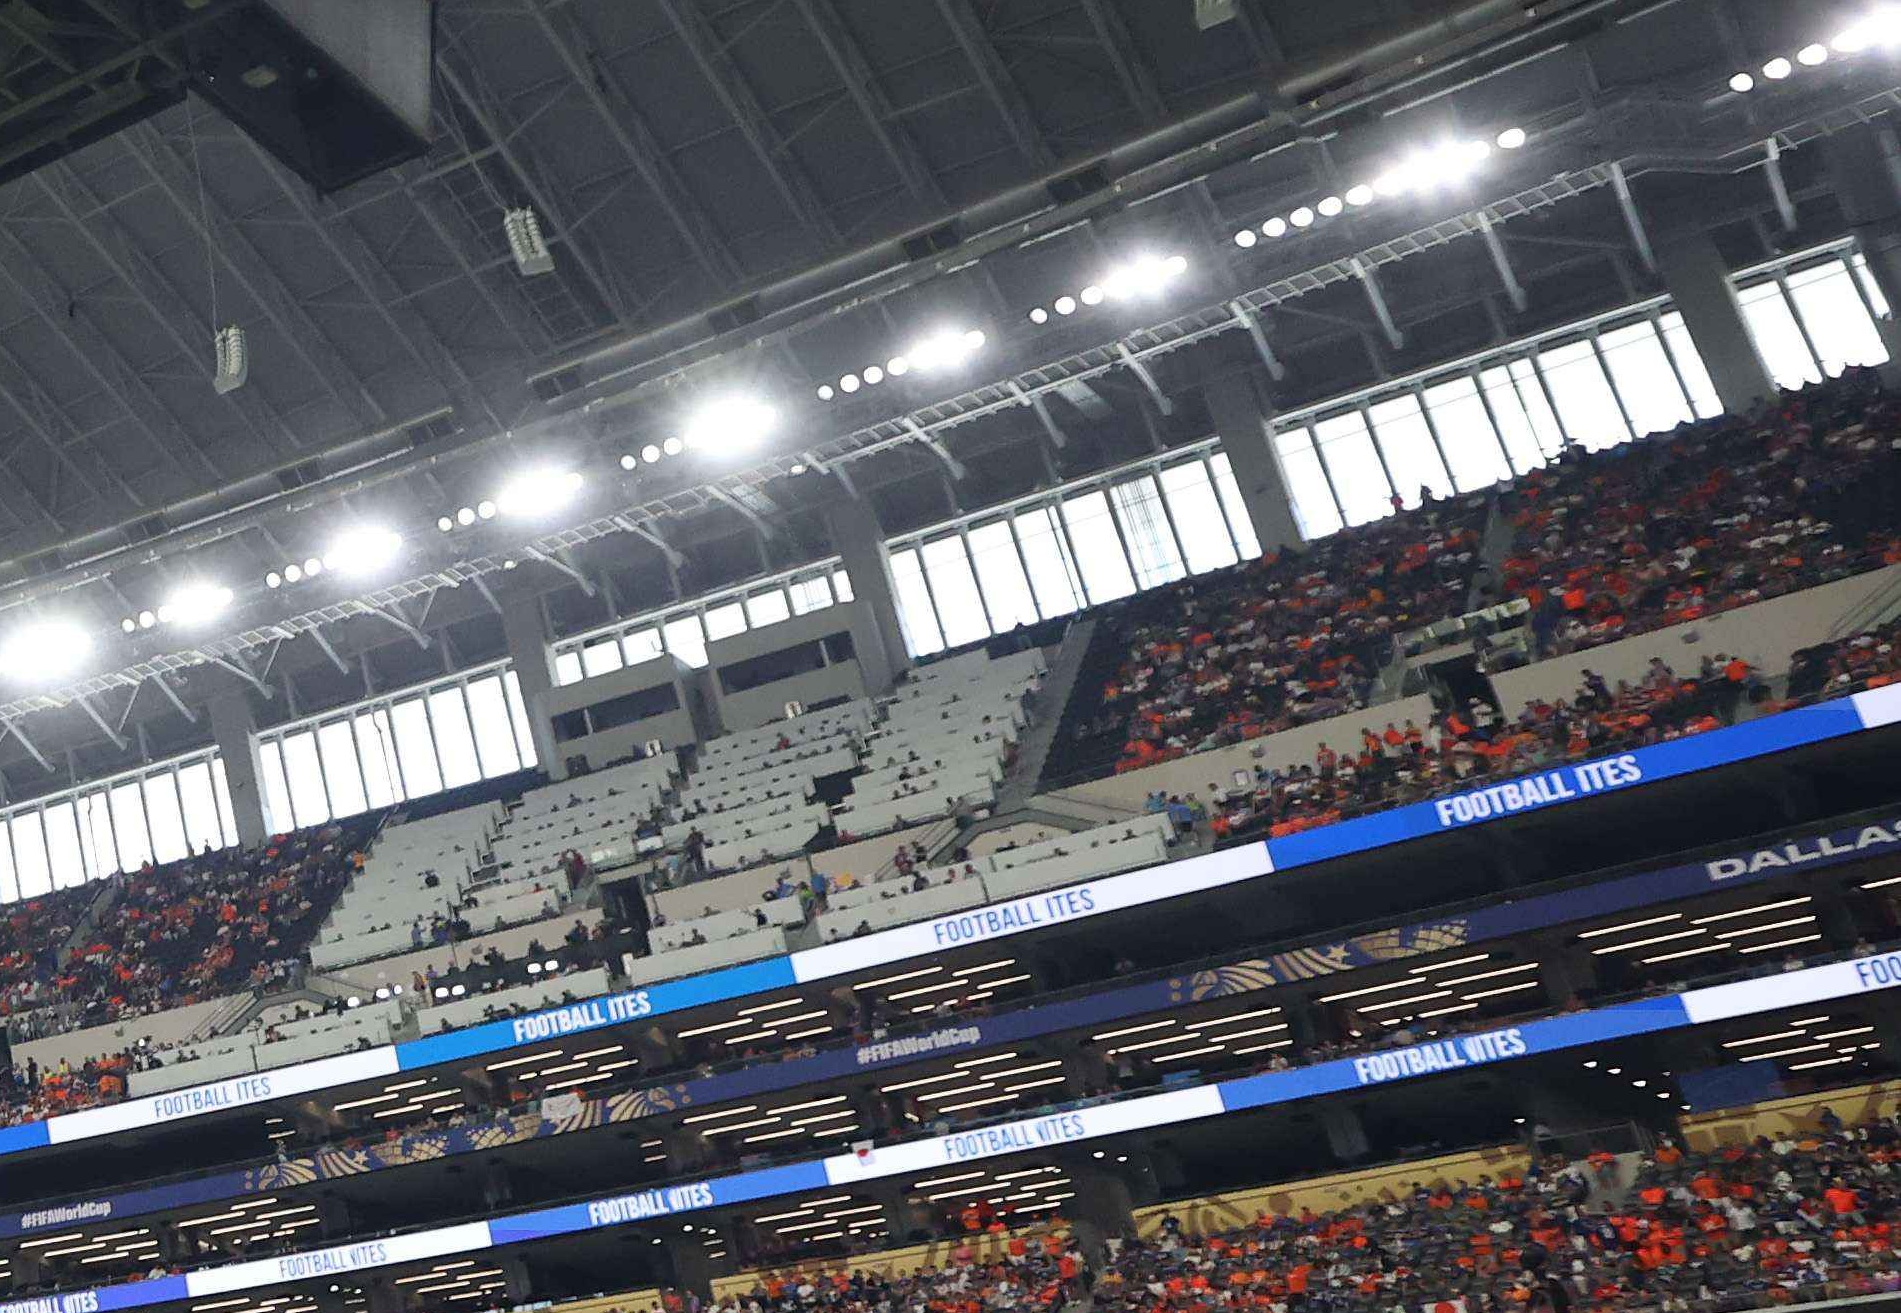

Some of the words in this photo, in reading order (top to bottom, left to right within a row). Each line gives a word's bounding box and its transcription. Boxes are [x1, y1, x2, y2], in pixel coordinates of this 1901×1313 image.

[1438, 774, 1574, 824] FOOTBALL
[933, 903, 1042, 944] FOOTBALL
[514, 1004, 606, 1040] FOOTBALL
[857, 1027, 981, 1064] #FIFAWorldCup
[1355, 1042, 1462, 1082] FOOTBALL
[155, 1087, 232, 1117] FOOTBALL
[944, 1126, 1033, 1159] FOOTBALL
[21, 1201, 111, 1229] #FIFAWorldCup
[589, 1193, 666, 1223] FOOTBALL
[279, 1252, 347, 1277] FOOTBALL
